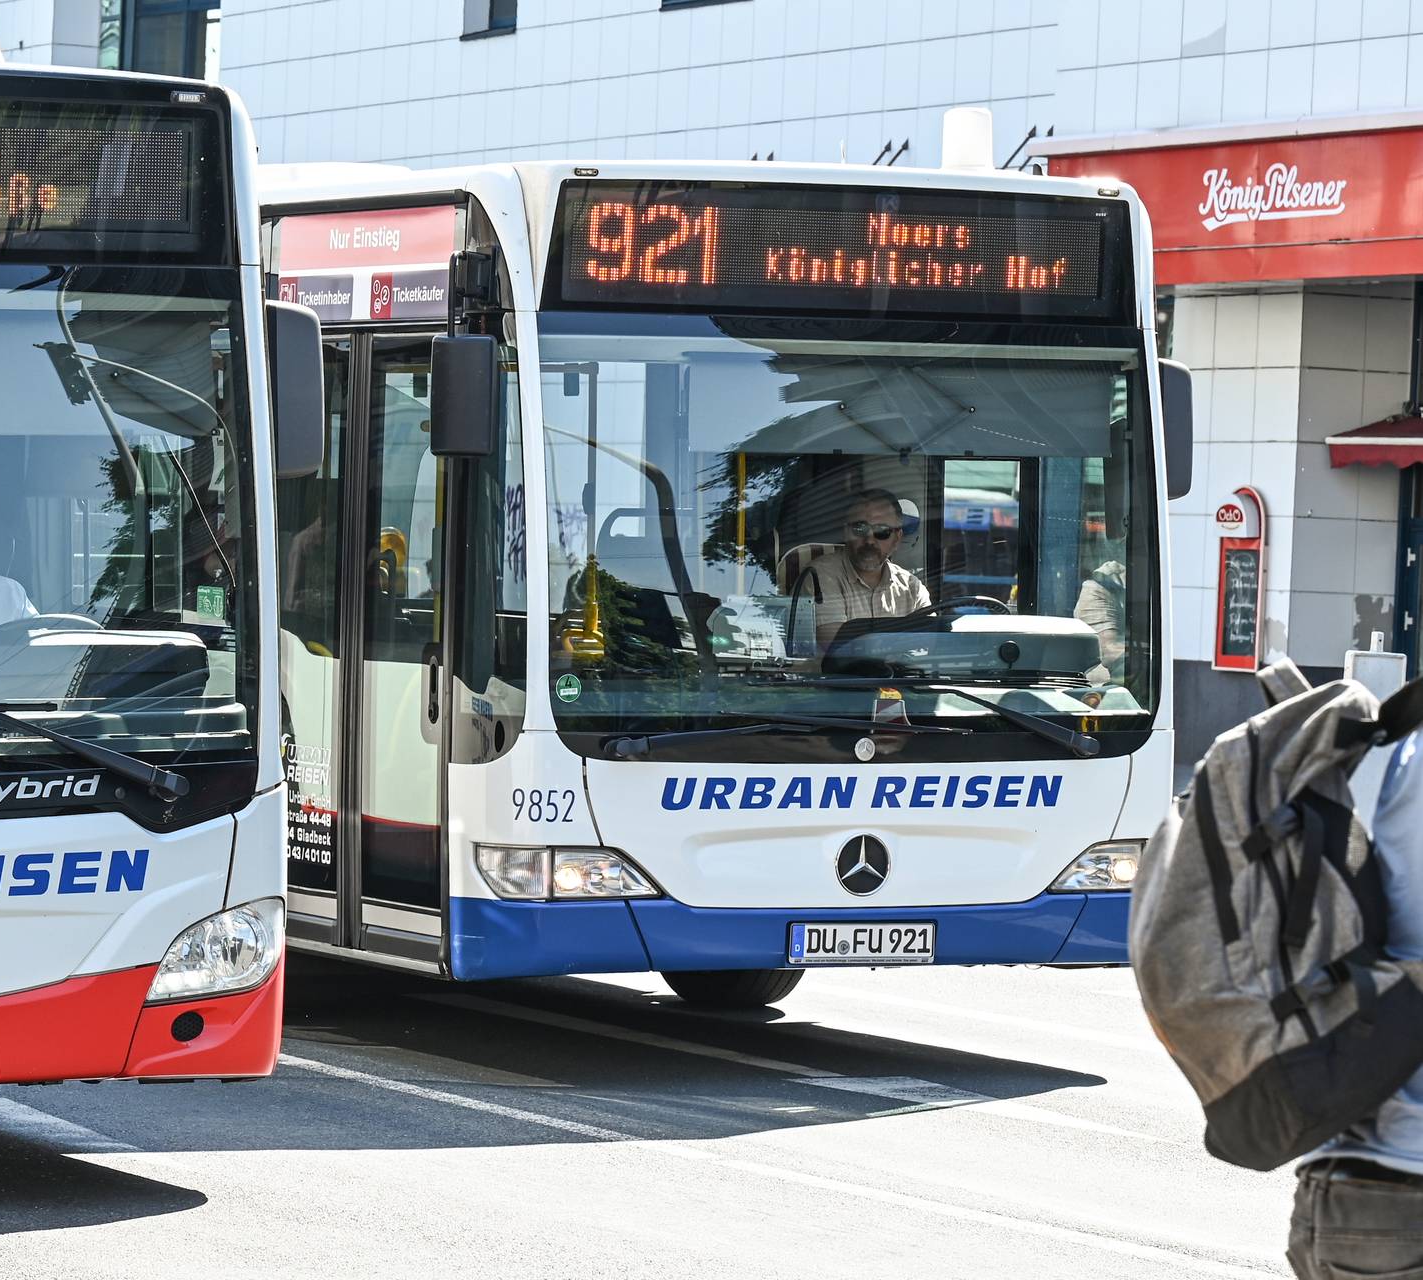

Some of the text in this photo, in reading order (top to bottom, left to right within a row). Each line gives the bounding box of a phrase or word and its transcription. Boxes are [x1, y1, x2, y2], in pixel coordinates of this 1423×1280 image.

[1198, 162, 1347, 221] König Pilsener
[329, 226, 401, 252] Nur Einstieg
[586, 202, 719, 285] 921
[867, 212, 971, 249] Moers
[767, 247, 1068, 289] Königlicher Hof
[297, 289, 351, 306] Ticketinhaber
[393, 286, 444, 303] Ticketkäufer
[286, 743, 331, 767] URBAN
[286, 765, 330, 787] REISEN
[288, 790, 310, 806] Urban
[511, 788, 576, 824] 9852
[660, 775, 1064, 812] URBAN REISEN
[296, 827, 332, 847] Gladbeck
[794, 944, 801, 952] D
[806, 928, 931, 954] DU FU 921
